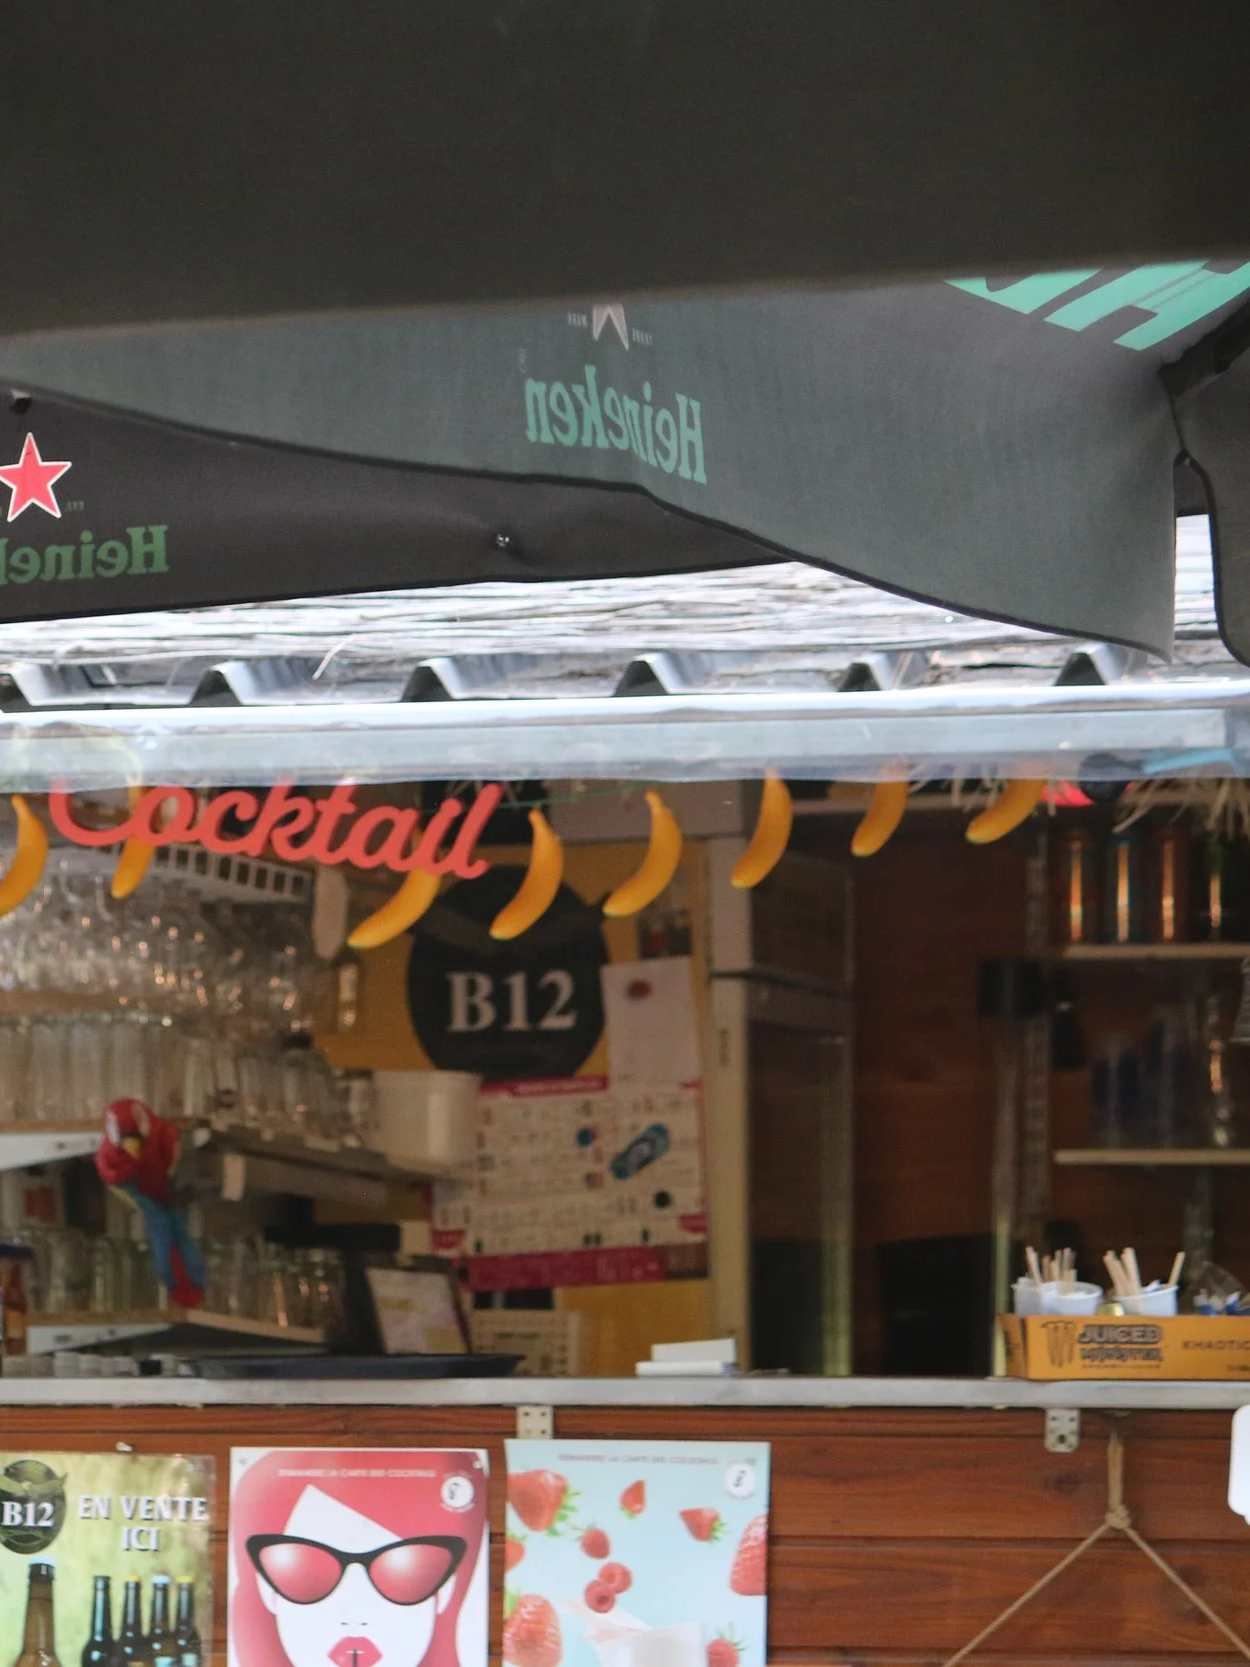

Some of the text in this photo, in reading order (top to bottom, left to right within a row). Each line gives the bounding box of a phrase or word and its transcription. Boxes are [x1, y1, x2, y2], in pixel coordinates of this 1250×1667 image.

[48, 774, 503, 879] Cocktail
[445, 968, 579, 1033] B12
[1078, 1324, 1163, 1344] JUICED
[1, 1501, 54, 1527] B12
[78, 1494, 210, 1522] EN VENTE
[122, 1526, 161, 1552] ICI
